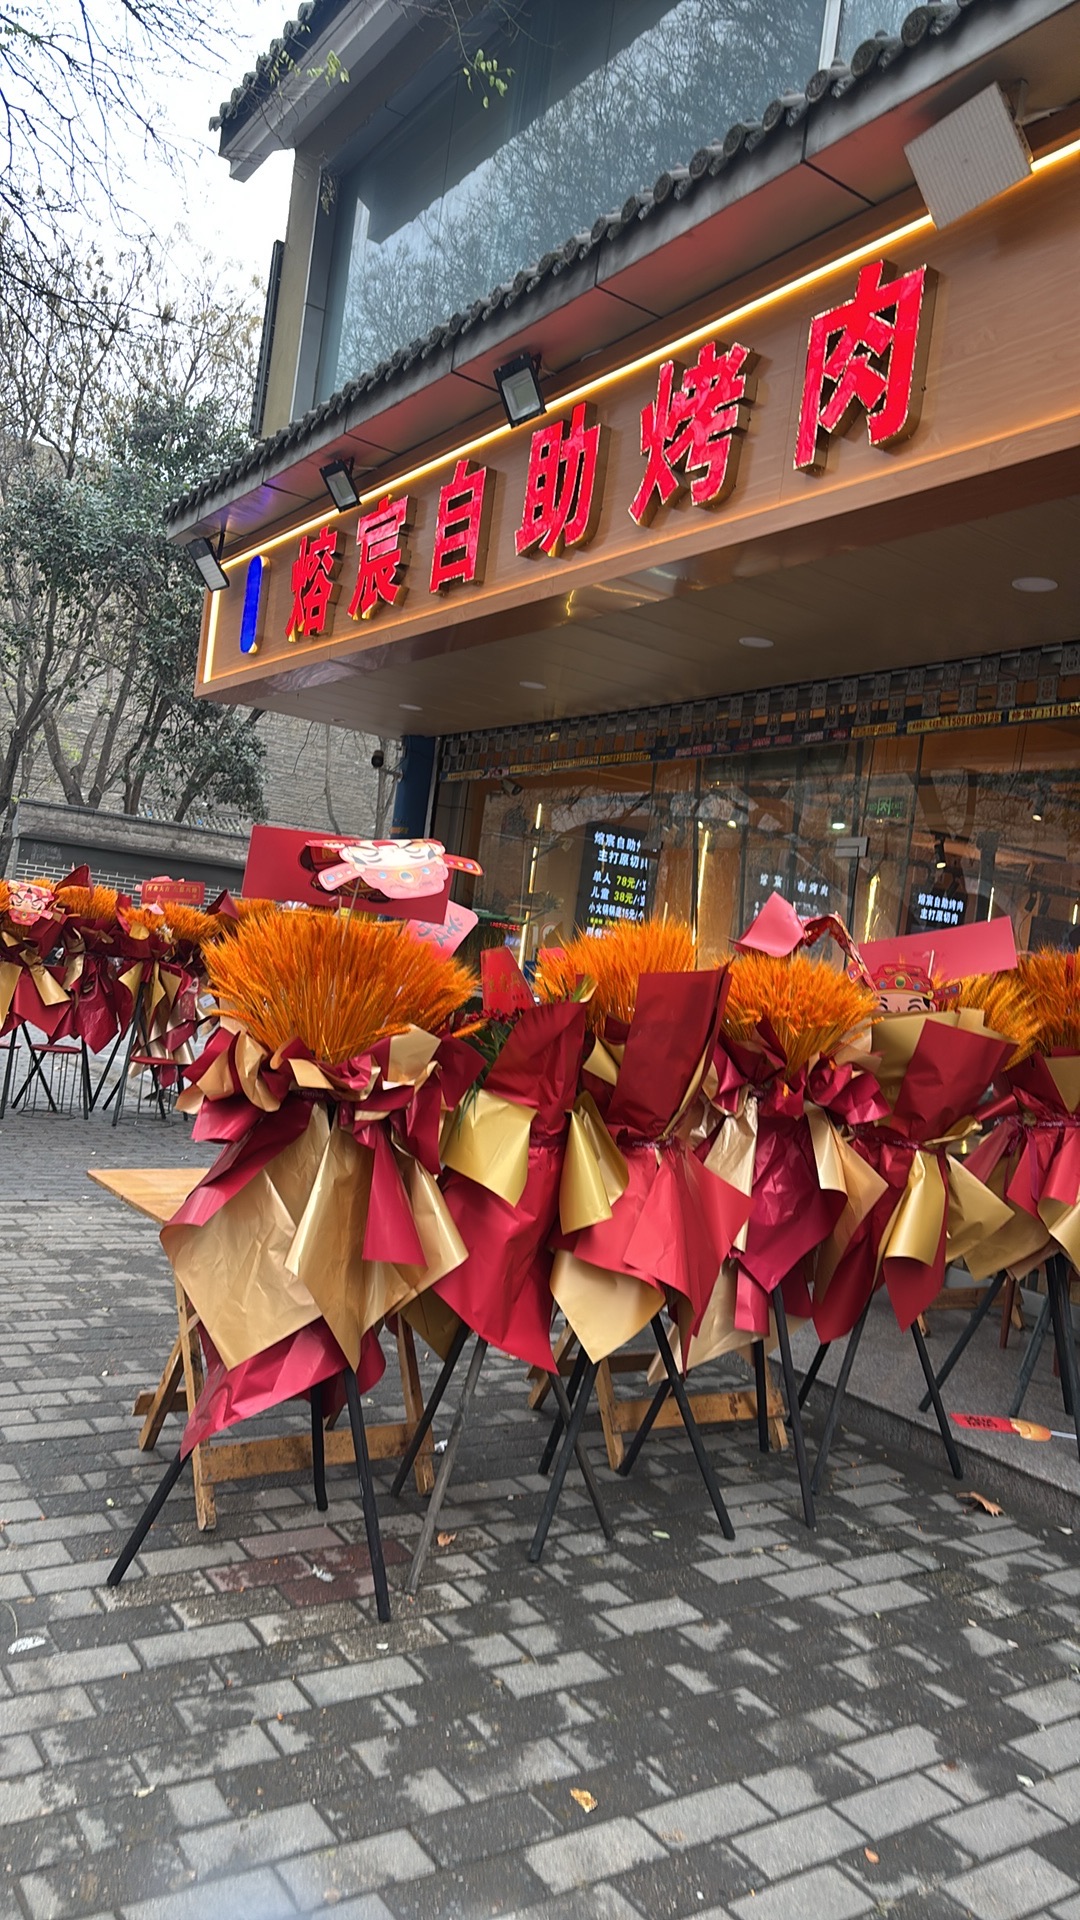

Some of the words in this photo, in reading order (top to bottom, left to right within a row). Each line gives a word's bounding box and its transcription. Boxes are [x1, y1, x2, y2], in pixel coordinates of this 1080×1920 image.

[285, 259, 932, 642] 熔宸自助烤肉
[594, 831, 641, 852] 熔宸自助
[592, 870, 611, 885] 单人
[590, 885, 610, 900] 儿童
